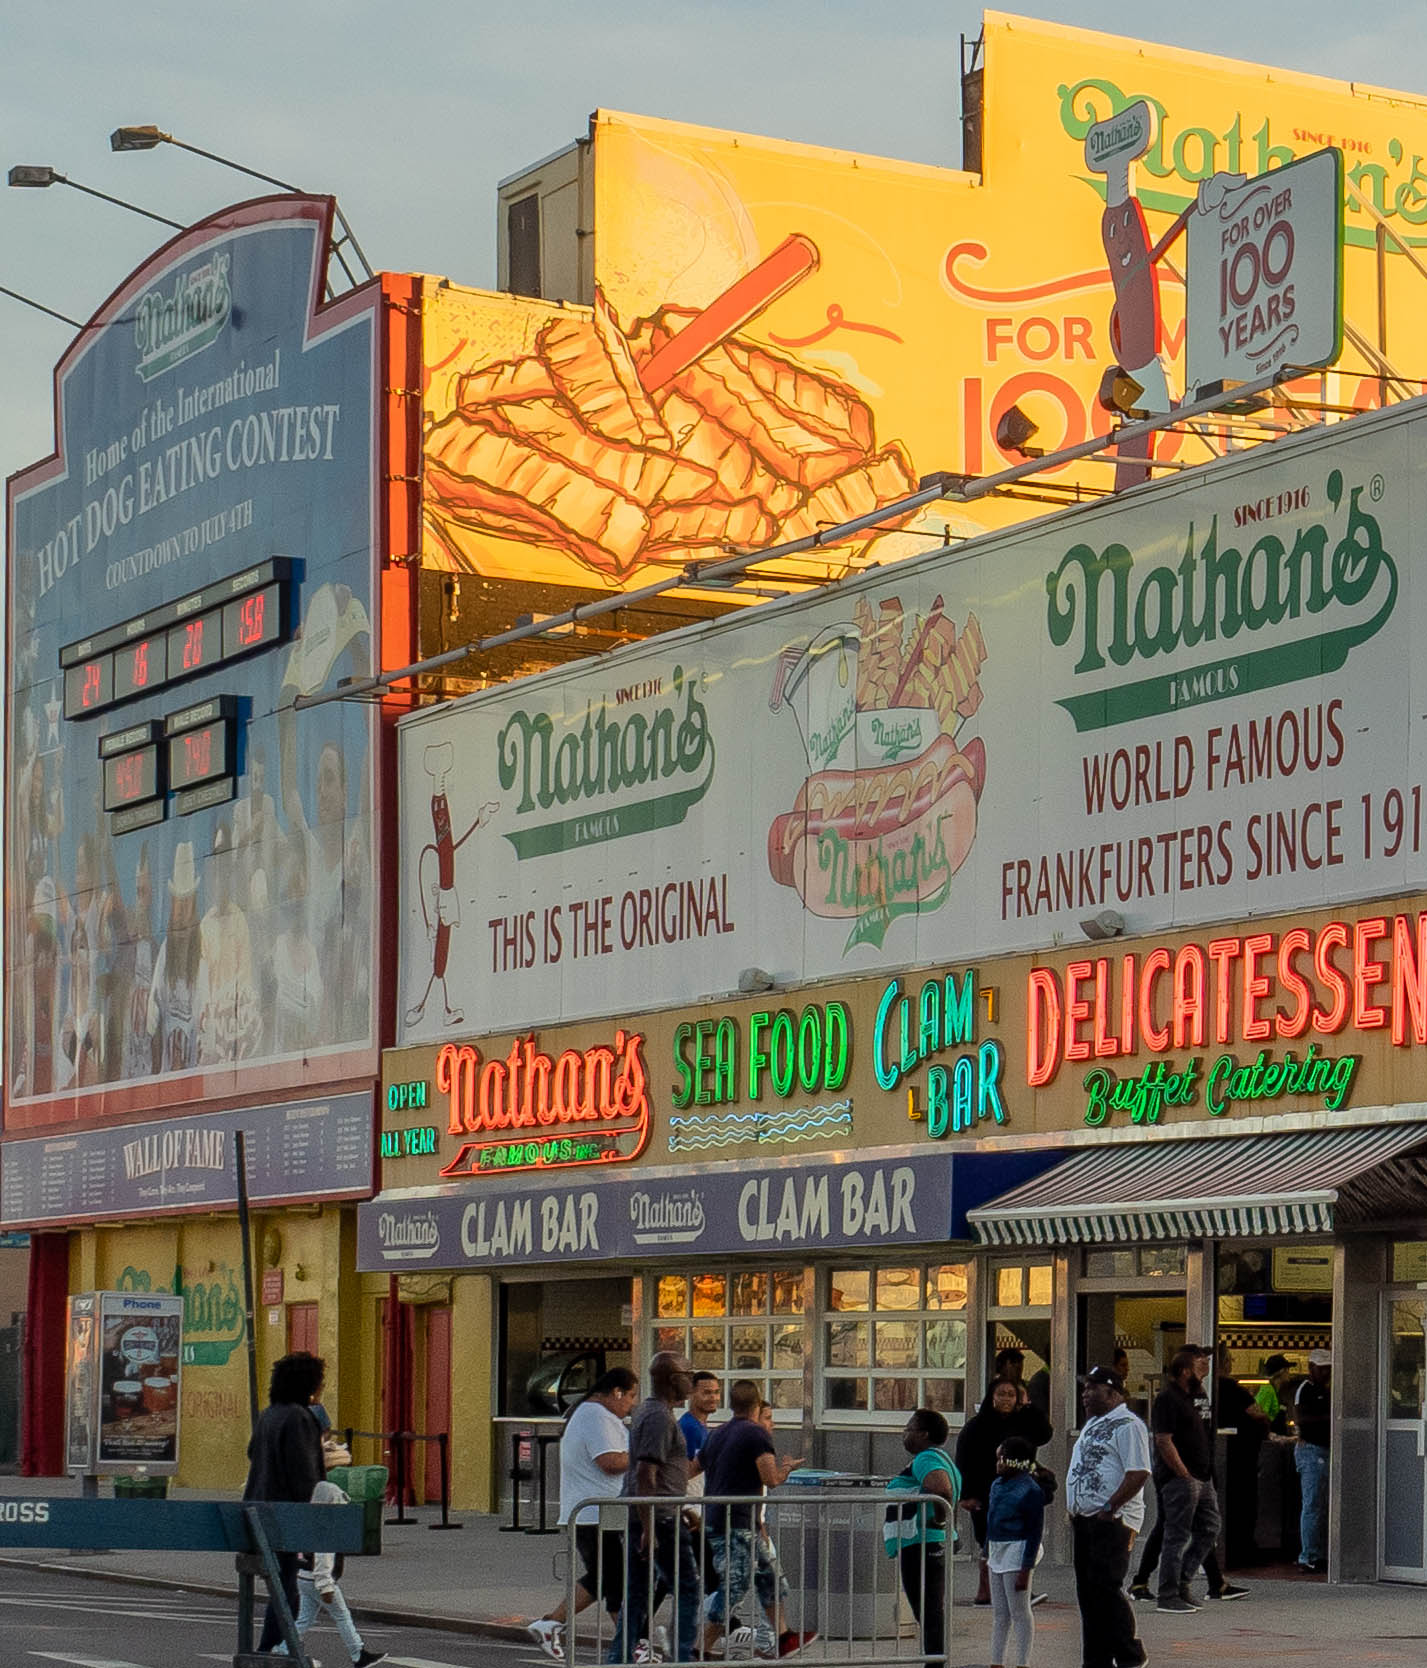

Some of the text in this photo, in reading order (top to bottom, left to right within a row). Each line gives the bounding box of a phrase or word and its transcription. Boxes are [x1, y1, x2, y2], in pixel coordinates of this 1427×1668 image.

[1090, 118, 1144, 155] Nathan's
[1220, 187, 1293, 252] FOR OVER
[1218, 219, 1295, 319] 100
[986, 317, 1096, 361] FOR
[1218, 284, 1296, 358] YEARS
[86, 348, 281, 487] Home of the International
[38, 404, 340, 598] HOT DOG EATING CONTEST
[105, 498, 254, 591] COUNTDOWN TO JULY 4TH
[1233, 486, 1311, 529] SINCE 1916
[1045, 468, 1386, 675] Nathan's
[616, 686, 640, 706] SINCE
[1169, 664, 1239, 705] FAMOUS
[498, 664, 709, 815] Nathan's
[871, 717, 922, 747] Nathan's
[1082, 699, 1345, 816] WORLD FAMOUS
[574, 815, 621, 841] FAMOUS
[818, 814, 949, 909] Nathan's
[1001, 819, 1233, 921] FRANKFURTERS
[1246, 799, 1344, 882] SINCE
[488, 872, 735, 975] THIS IS THE ORIGINAL
[671, 1001, 852, 1110] SEA FOOD
[873, 969, 976, 1093] CLAM
[388, 1079, 426, 1112] OPEN
[436, 1030, 648, 1136] Nathan's
[928, 1039, 1007, 1140] BAR
[1084, 1044, 1357, 1127] Buffet Catering
[123, 1132, 161, 1180] WALL
[163, 1130, 183, 1170] OF
[184, 1129, 225, 1171] FAME
[381, 1126, 438, 1159] ALL YEAR
[480, 1139, 574, 1169] FAMOUS
[378, 1167, 917, 1260] Nathan's CLAM BAR Nathan's CLAM BAR
[122, 1298, 162, 1312] Phone
